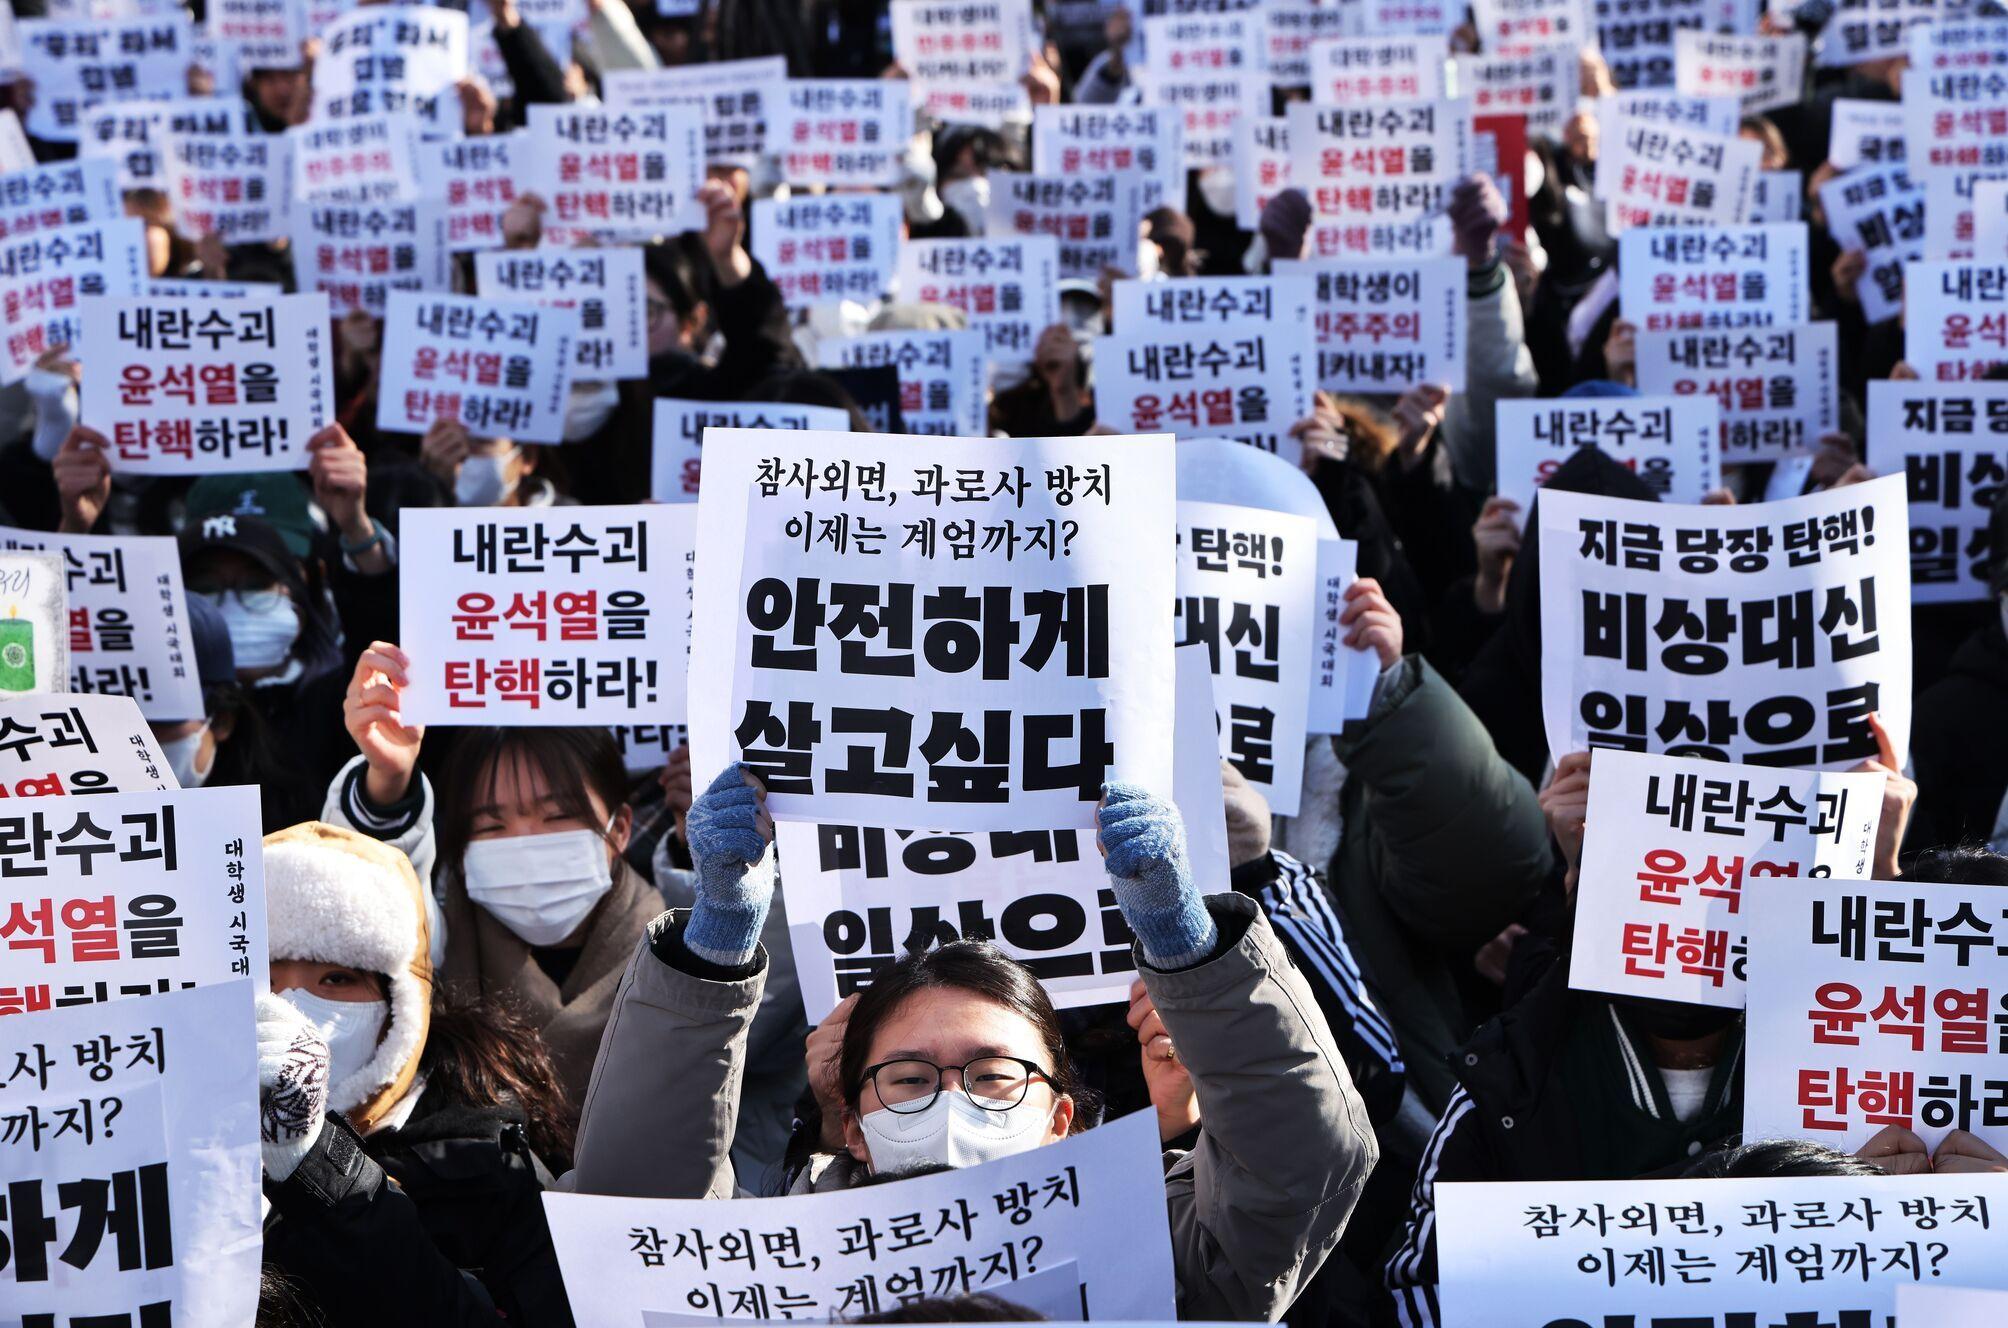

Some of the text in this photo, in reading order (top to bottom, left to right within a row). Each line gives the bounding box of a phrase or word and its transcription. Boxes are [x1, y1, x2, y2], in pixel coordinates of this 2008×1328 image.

[118, 306, 276, 351] 내란수괴
[1669, 332, 1797, 370] 내란수괴
[118, 362, 280, 407] 윤석열을
[1128, 336, 1266, 381] 내란수괴
[1130, 387, 1270, 432] 윤석열을
[1903, 398, 1975, 433] 지금
[113, 416, 289, 461] 탄핵하라!
[755, 457, 897, 507] 참사외면,
[912, 463, 1032, 509] 과로사
[1046, 463, 1111, 507] 방치
[453, 520, 648, 575] 내란수괴
[784, 511, 1080, 561] 이제는 계엄까지?
[1191, 527, 1284, 579] 탄핵!
[1578, 505, 1876, 575] 지금 당장 탄핵!
[451, 590, 650, 641] 윤석열을
[746, 576, 1110, 681] 안전하게
[1581, 575, 1880, 676] 비상대신
[444, 657, 658, 710] 탄핵하라!
[734, 700, 1114, 803] 살고싶다
[1645, 773, 1849, 845] 내란수괴
[224, 837, 251, 978] 대학생 시국대
[1811, 895, 2008, 967] 내란수
[0, 1027, 166, 1091] 사 방치
[627, 1165, 1082, 1271] 참사외면, 과로사 방치
[1522, 1195, 1991, 1239] 참사외면, 과로사 방치
[1576, 1240, 1951, 1287] 이제는 계엄까지?
